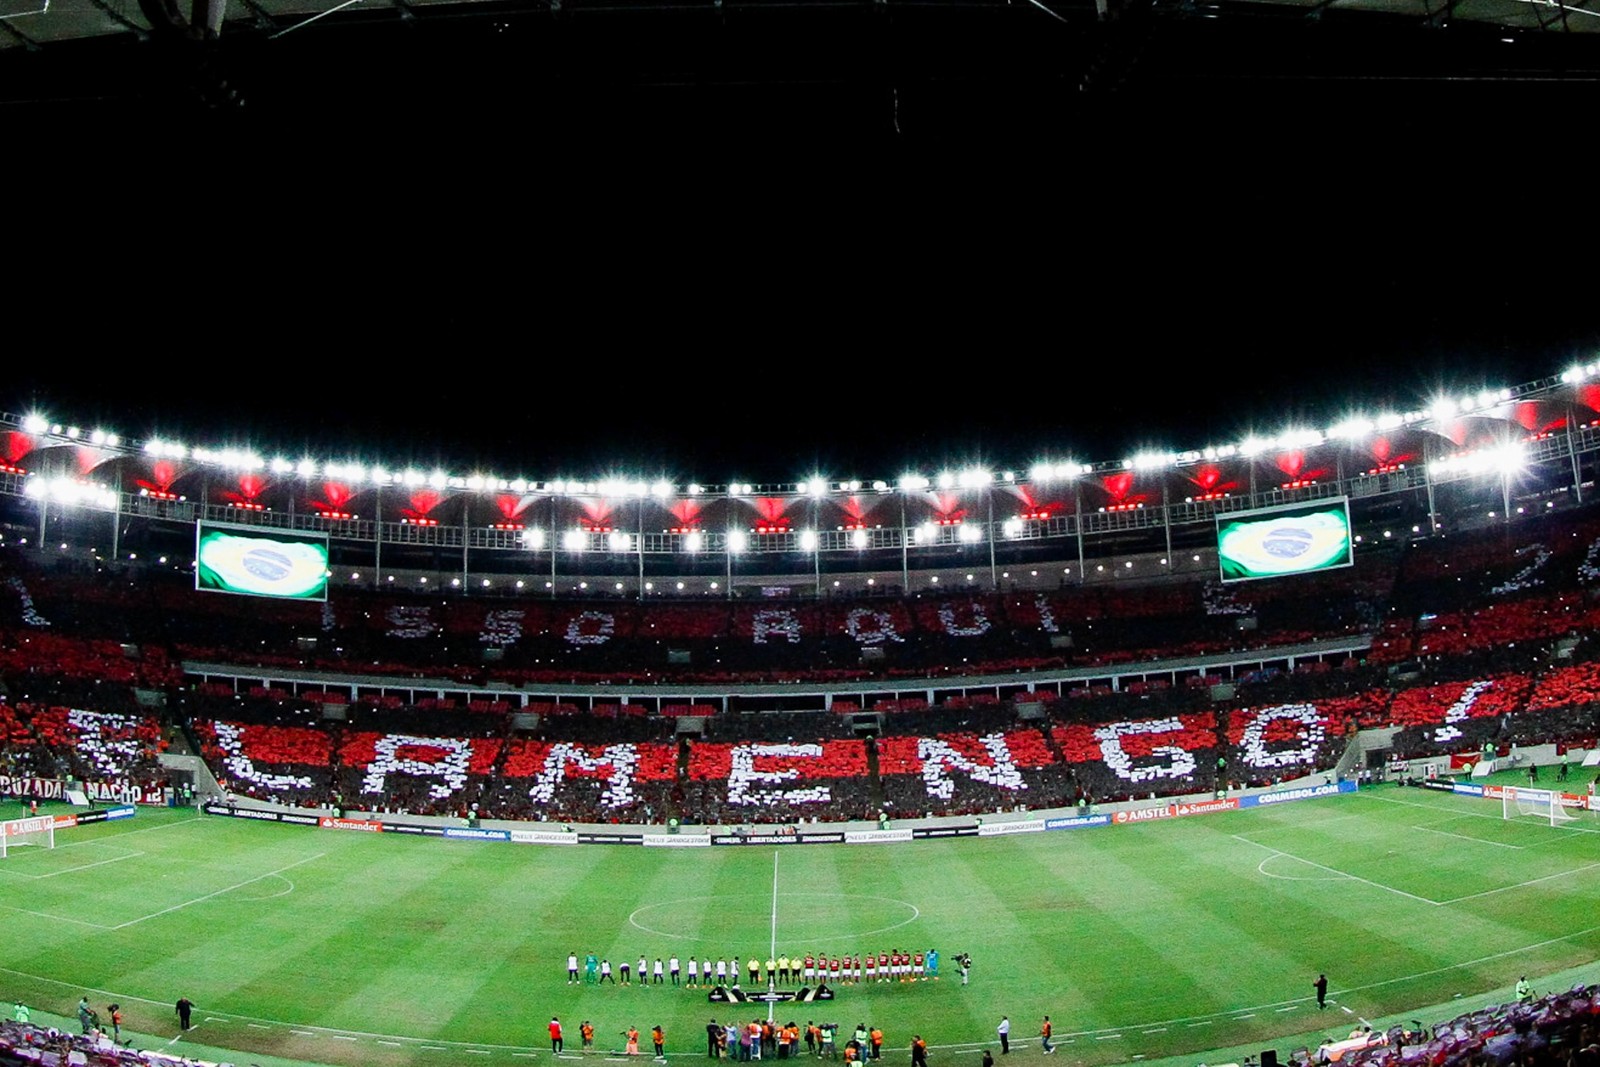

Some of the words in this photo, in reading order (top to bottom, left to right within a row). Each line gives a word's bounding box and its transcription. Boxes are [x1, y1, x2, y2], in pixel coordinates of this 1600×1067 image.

[1259, 784, 1339, 804] CONMEBOL.COM
[1129, 806, 1172, 821] AMSTEL
[1190, 800, 1235, 814] Santander
[333, 817, 378, 832] Santander
